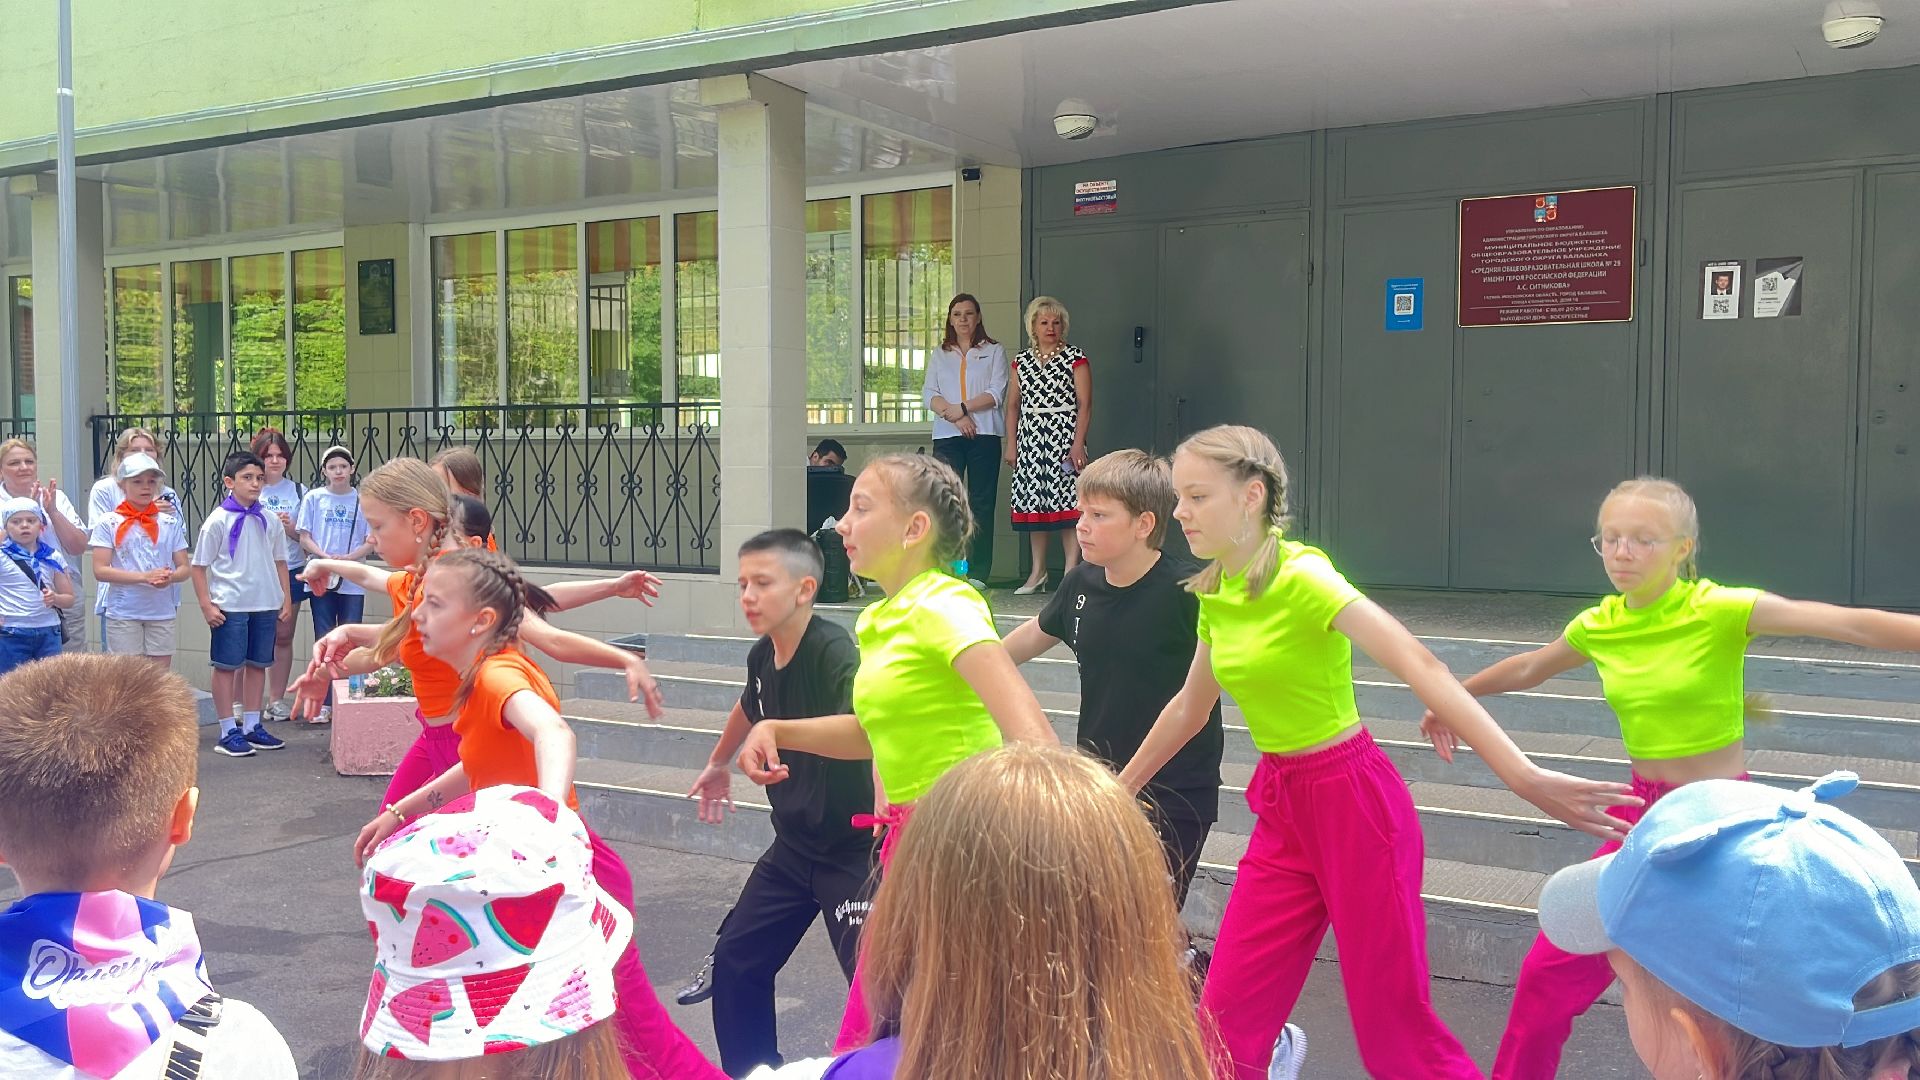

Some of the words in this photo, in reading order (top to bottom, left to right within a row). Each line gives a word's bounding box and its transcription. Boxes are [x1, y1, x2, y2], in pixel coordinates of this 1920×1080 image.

[1484, 241, 1553, 250] МУНИЦИПАЛЬНОЕ
[1554, 238, 1606, 246] БЮДЖЕТНОЕ
[1471, 247, 1567, 258] ОБЩЕОБРАЗОВАТЕЛЬНОЕ
[1568, 244, 1622, 252] УЧРЕЖДЕНИЕ
[1481, 256, 1531, 264] ГОРОДСКОГО
[1502, 262, 1580, 273] ОБЩЕОБРАЗОВАТЕЛЬНАЯ
[1581, 260, 1604, 269] ШКОЛА
[1505, 274, 1525, 282] ГЕРОЯ
[1525, 272, 1567, 281] РОССИЙСКОЙ
[1567, 270, 1607, 279] ФЕДЕРАЦИИ
